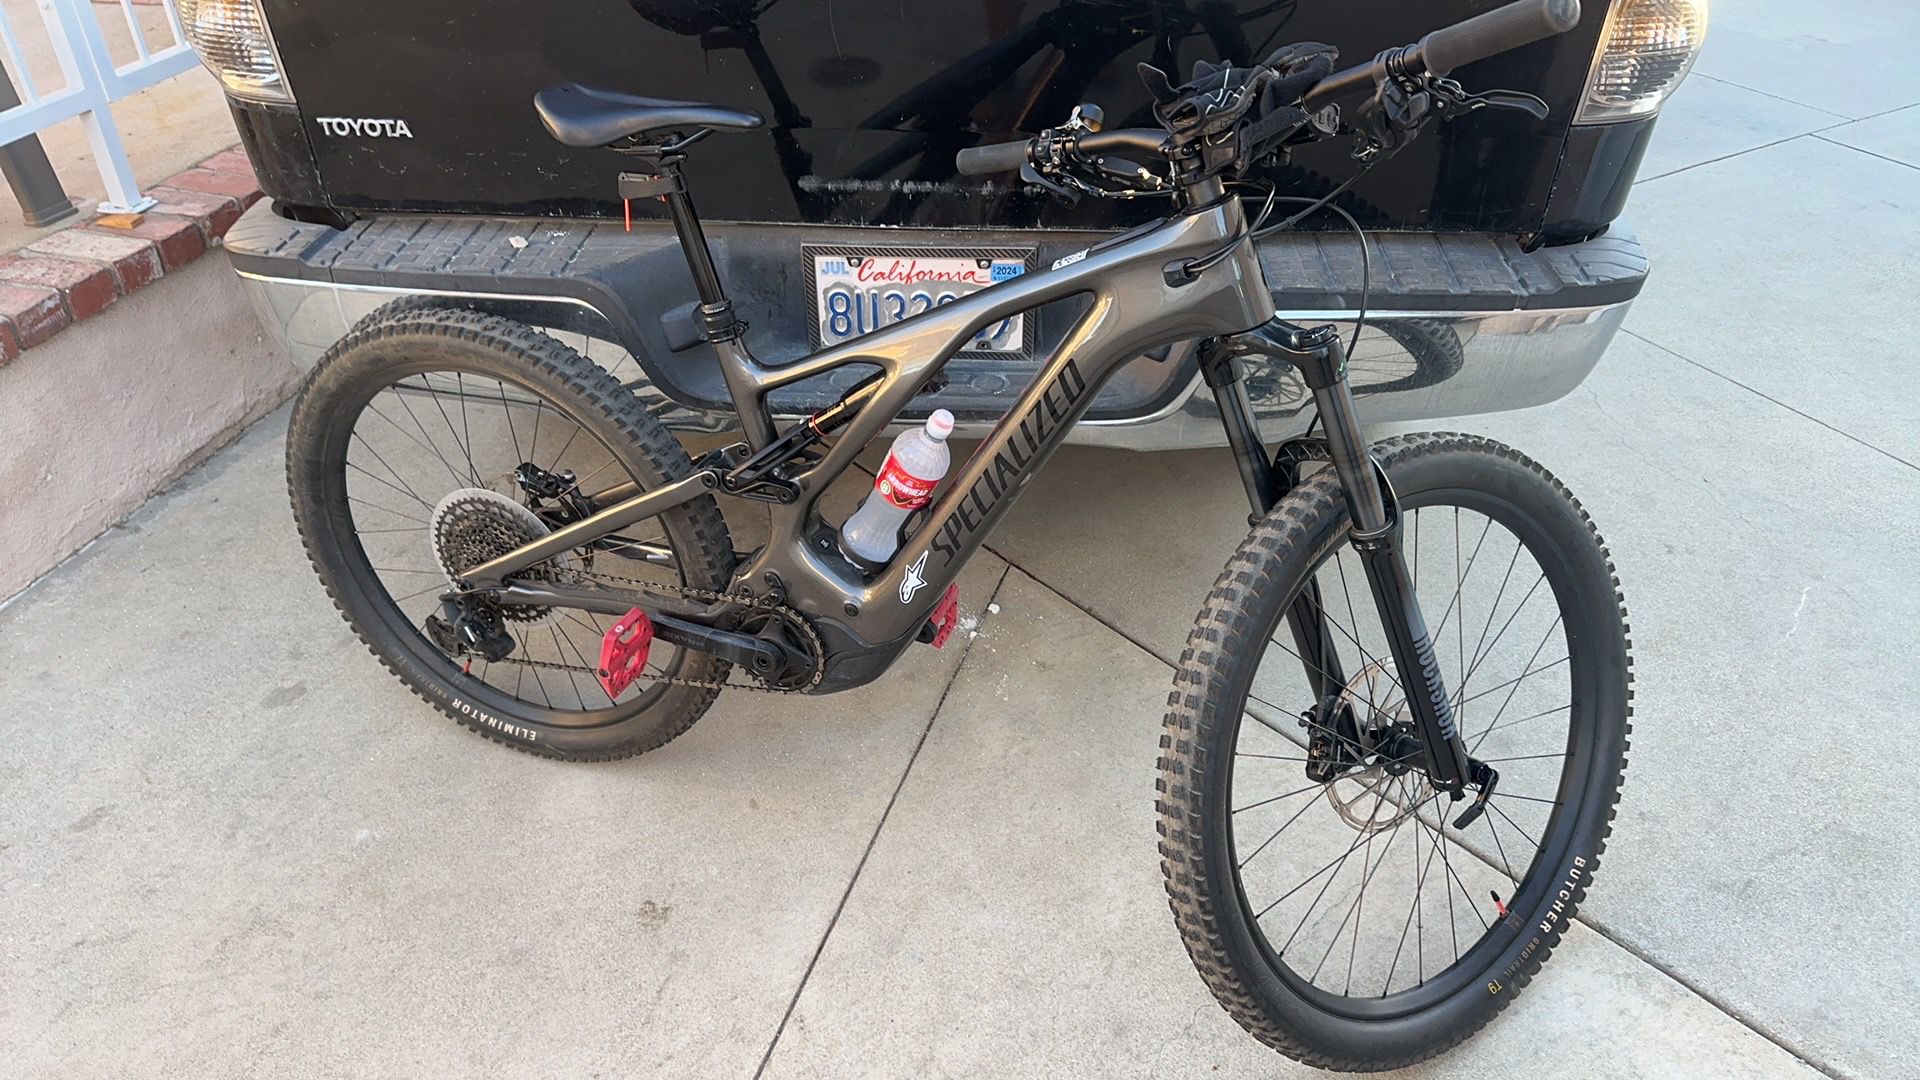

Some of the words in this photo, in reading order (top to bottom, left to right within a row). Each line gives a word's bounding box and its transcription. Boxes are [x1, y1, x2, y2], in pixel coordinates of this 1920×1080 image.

[316, 117, 413, 138] TOYOTA
[821, 261, 850, 276] JUL
[858, 258, 991, 285] California
[996, 266, 1017, 275] 2024
[931, 358, 1086, 567] SPECIALIZED
[452, 698, 537, 741] ELIMINATOR
[1540, 856, 1587, 934] BUTCHER
[1487, 978, 1503, 994] T9
